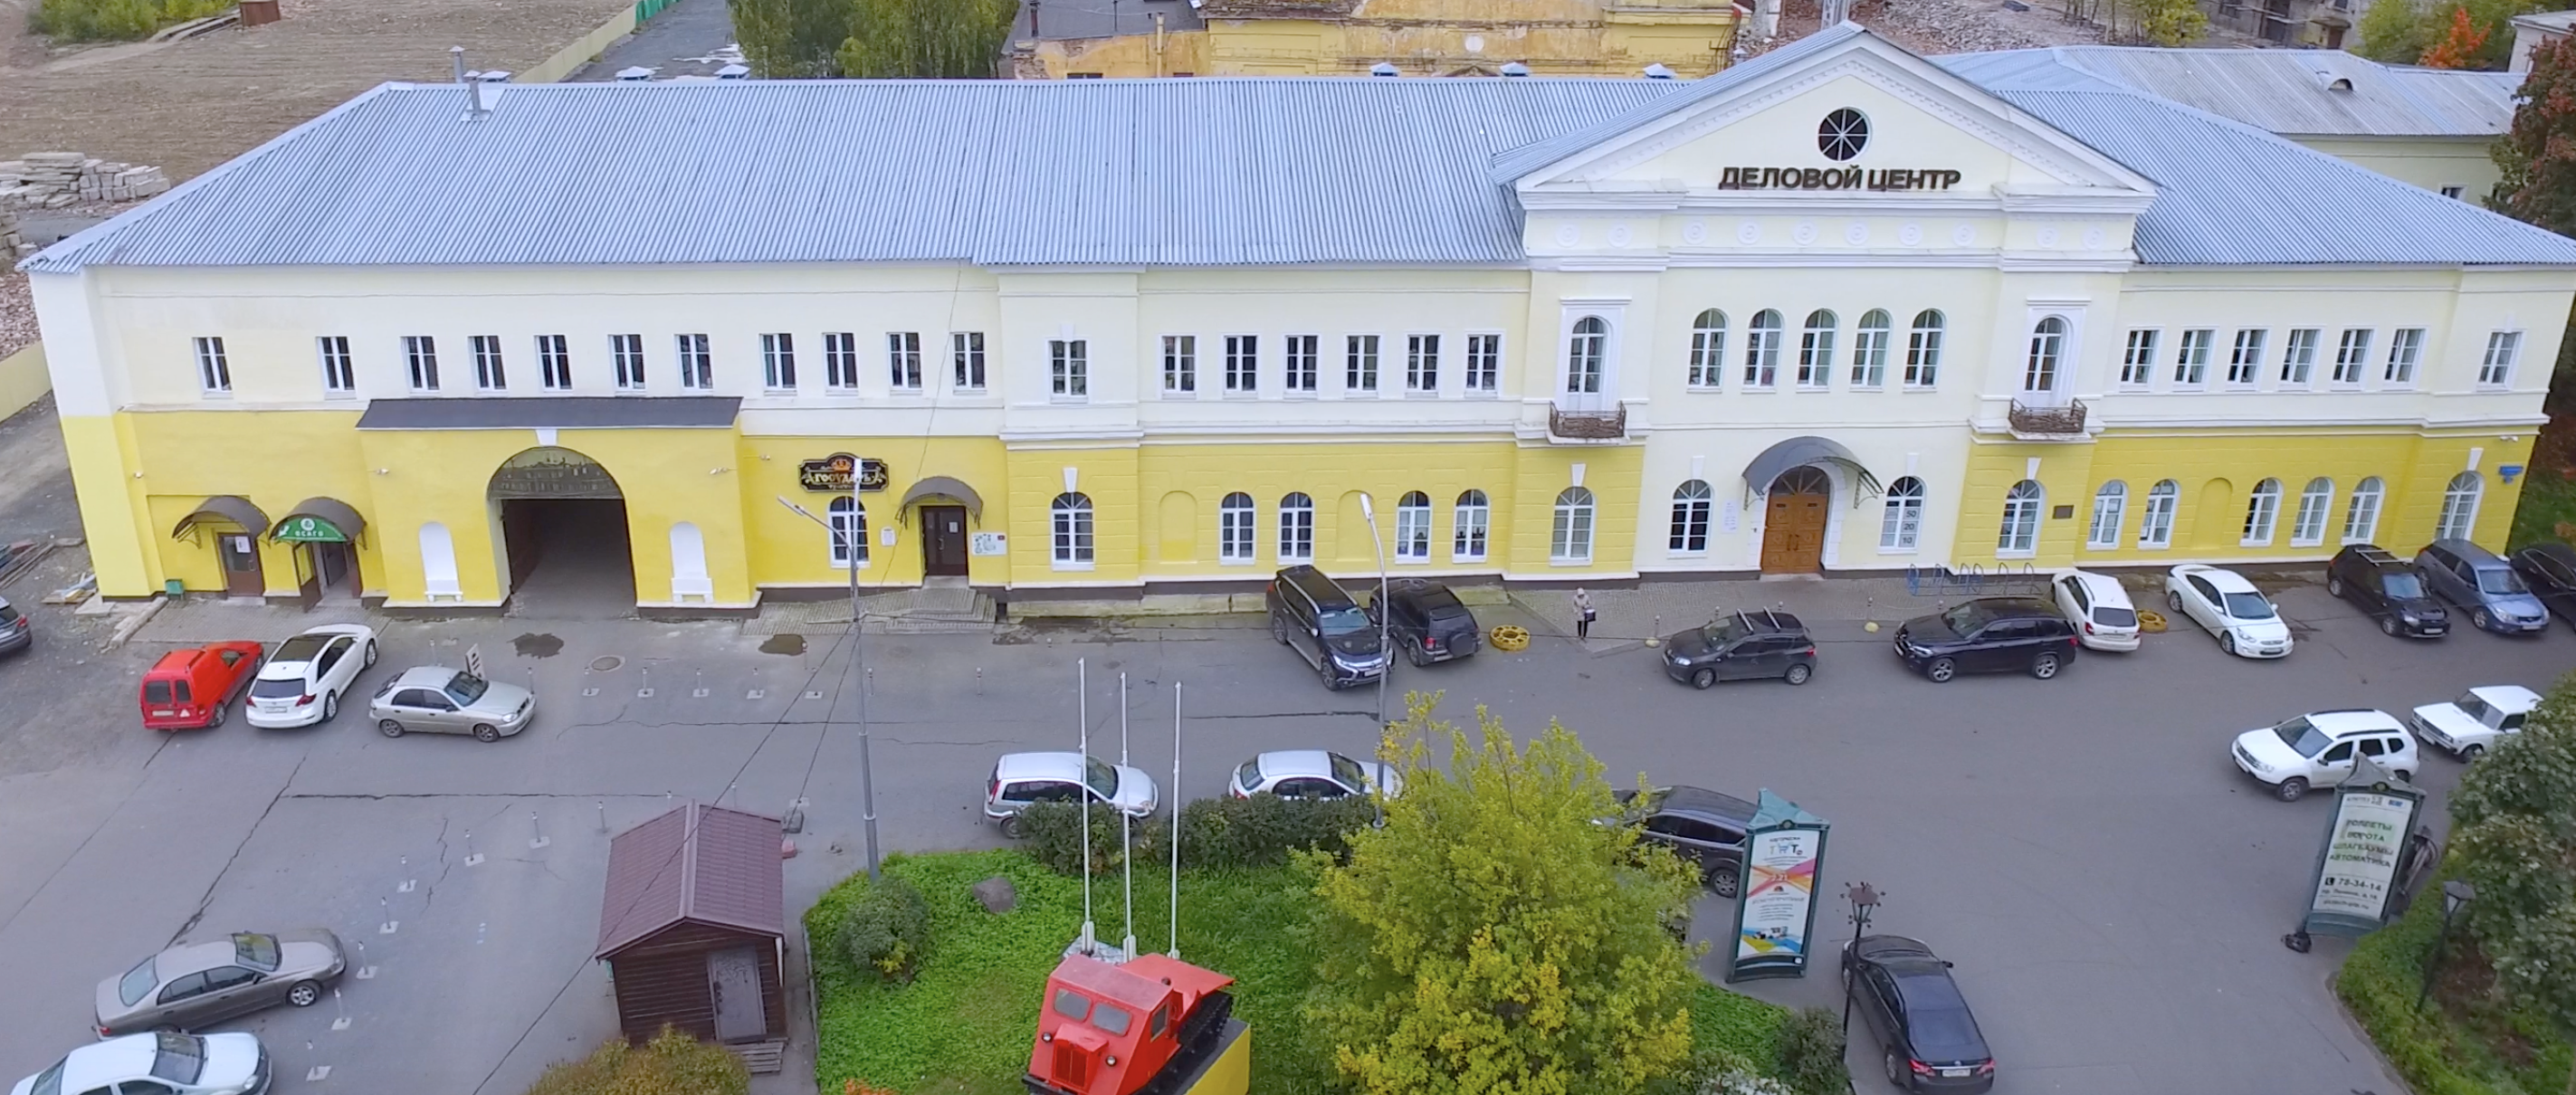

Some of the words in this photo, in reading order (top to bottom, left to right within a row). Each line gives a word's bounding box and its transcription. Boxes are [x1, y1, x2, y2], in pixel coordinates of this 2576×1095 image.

[1718, 165, 1863, 191] ДЕЛОВОЙ
[1867, 168, 1961, 193] ЦЕНТР
[814, 472, 872, 483] ГОСУДАЬ
[2330, 854, 2390, 867] АВТОМАТИКА
